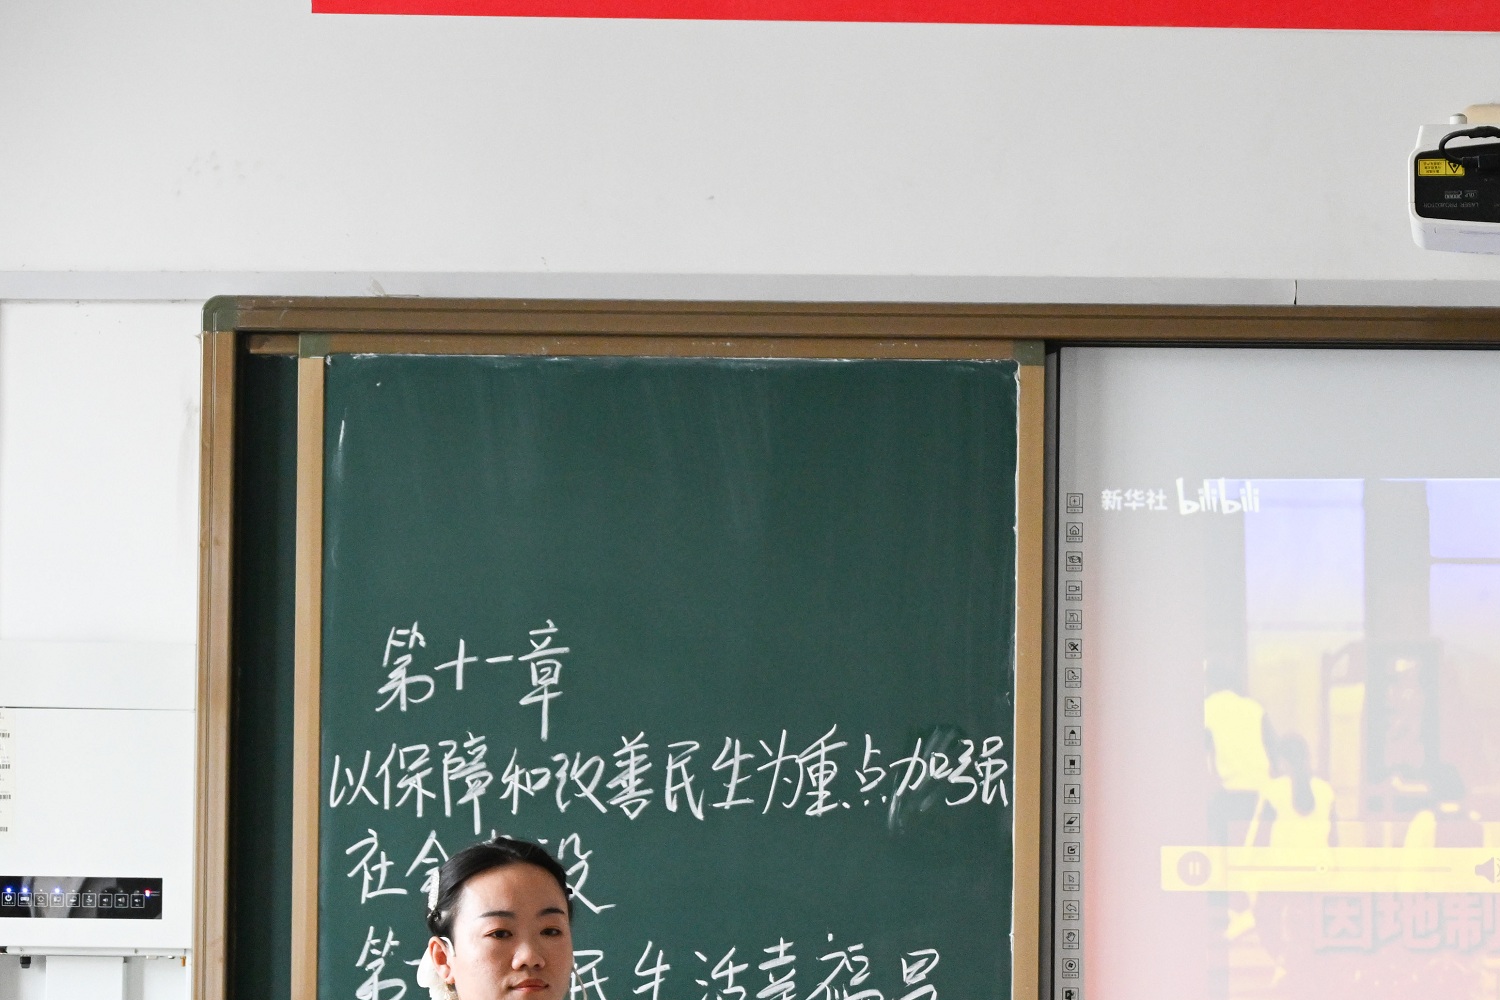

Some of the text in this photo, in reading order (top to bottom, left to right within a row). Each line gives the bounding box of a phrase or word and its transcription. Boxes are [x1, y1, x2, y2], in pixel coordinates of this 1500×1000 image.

[1101, 488, 1168, 512] 新华社
[1176, 477, 1260, 516] bilibili
[376, 620, 570, 740] 第十一章
[328, 723, 1010, 834] 以保障和改善民生为重点加强
[346, 828, 616, 914] 社会设
